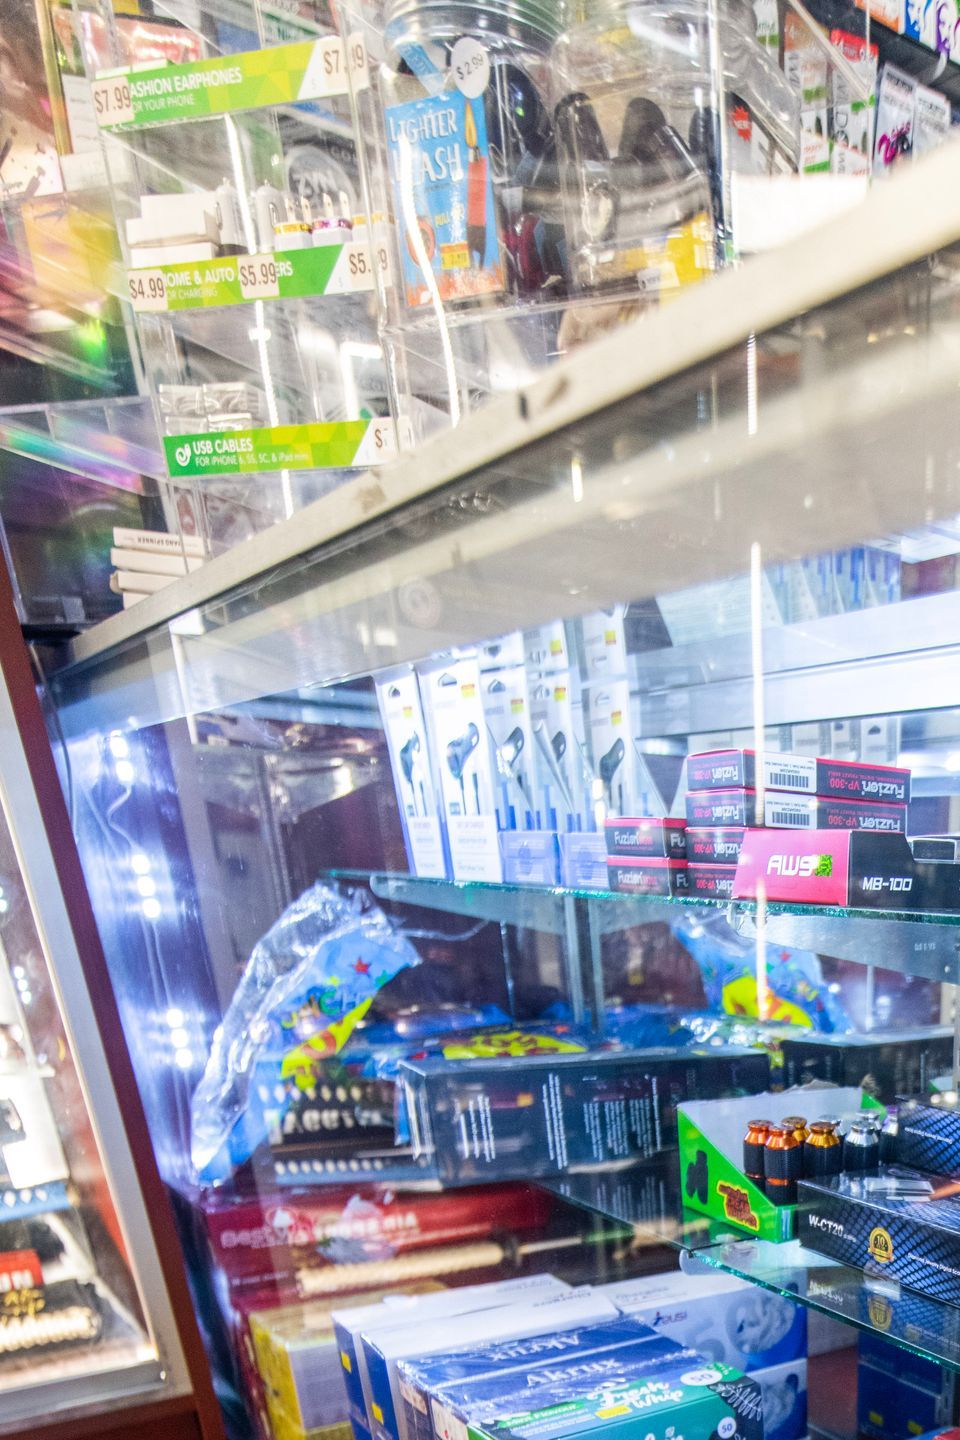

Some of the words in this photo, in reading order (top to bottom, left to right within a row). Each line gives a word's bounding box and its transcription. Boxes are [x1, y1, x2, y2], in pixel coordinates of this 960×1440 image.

[173, 67, 243, 93] EARPHONES
[94, 84, 131, 114] $7.99
[143, 97, 165, 112] YOUR
[167, 94, 195, 106] PHONE
[388, 108, 458, 143] LIGHTER
[193, 271, 201, 283] &
[204, 268, 235, 282] AUTO
[239, 262, 278, 287] $5.99
[128, 278, 165, 300] $4.99
[192, 439, 213, 456] USB
[214, 437, 253, 454] CABLES
[194, 455, 210, 467] FOR
[829, 778, 859, 790] VP-300
[861, 780, 905, 798] Fuzion
[827, 814, 857, 828] VP-300
[767, 854, 815, 877] AWS
[862, 876, 912, 892] MB-100
[808, 1213, 844, 1237] W-CT20
[526, 1357, 624, 1387] Akrux
[630, 1389, 684, 1409] Whip
[721, 1423, 733, 1433] 50
